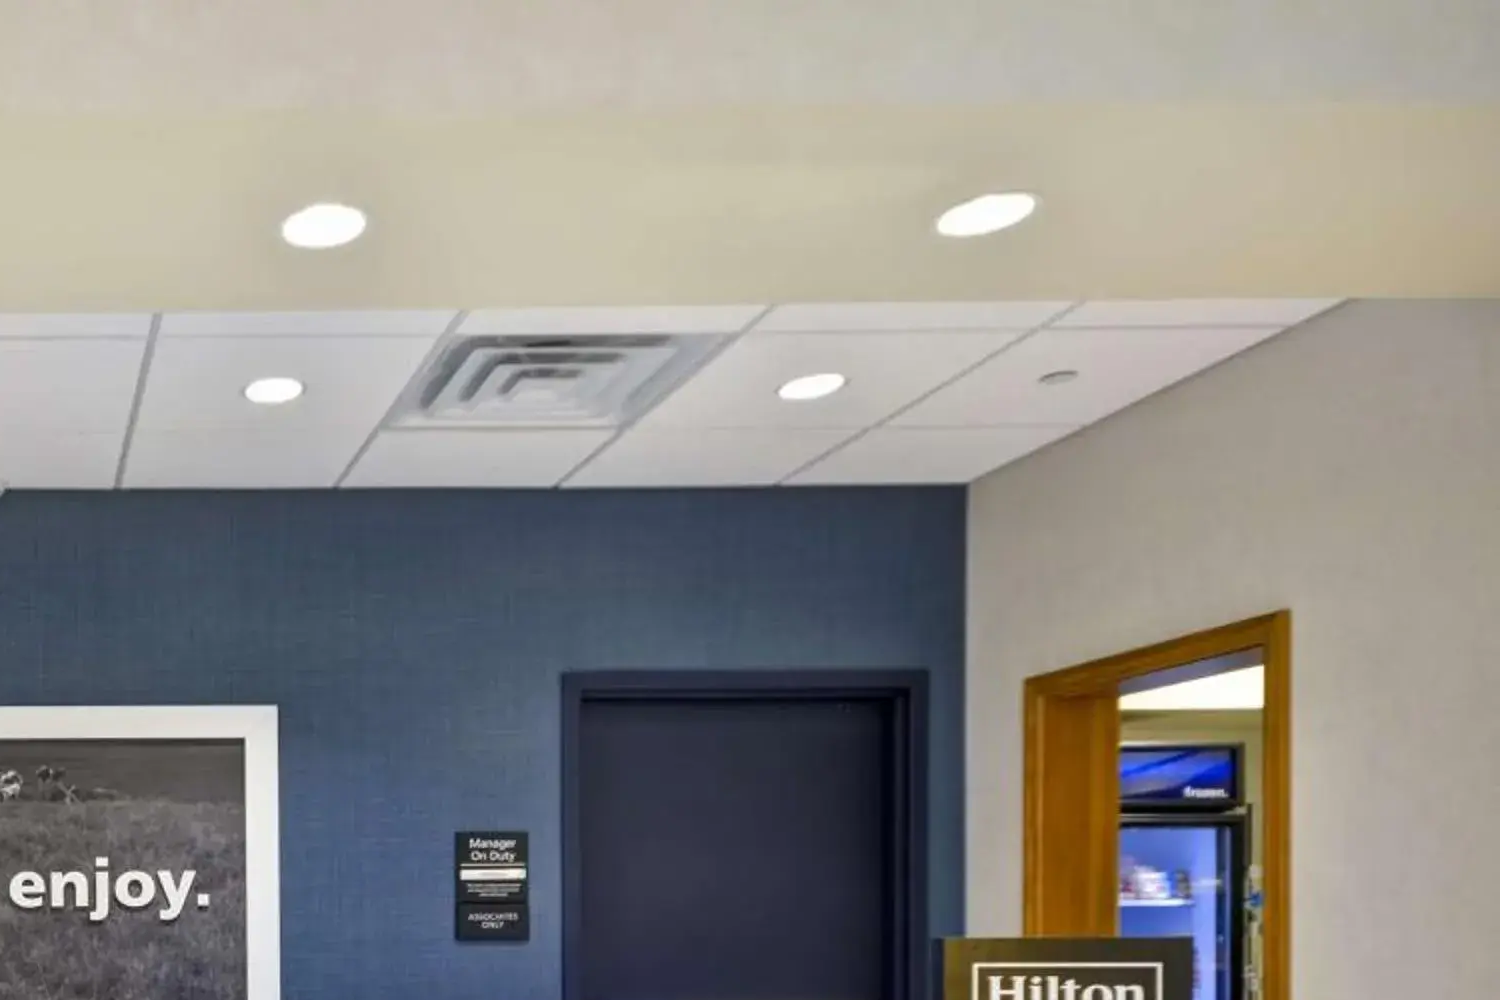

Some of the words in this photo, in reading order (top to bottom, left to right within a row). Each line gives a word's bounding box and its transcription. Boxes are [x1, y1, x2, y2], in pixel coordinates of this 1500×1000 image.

[469, 838, 516, 850] Manager
[471, 850, 487, 861] On
[489, 850, 516, 862] Duty
[9, 856, 210, 921] enjoy.
